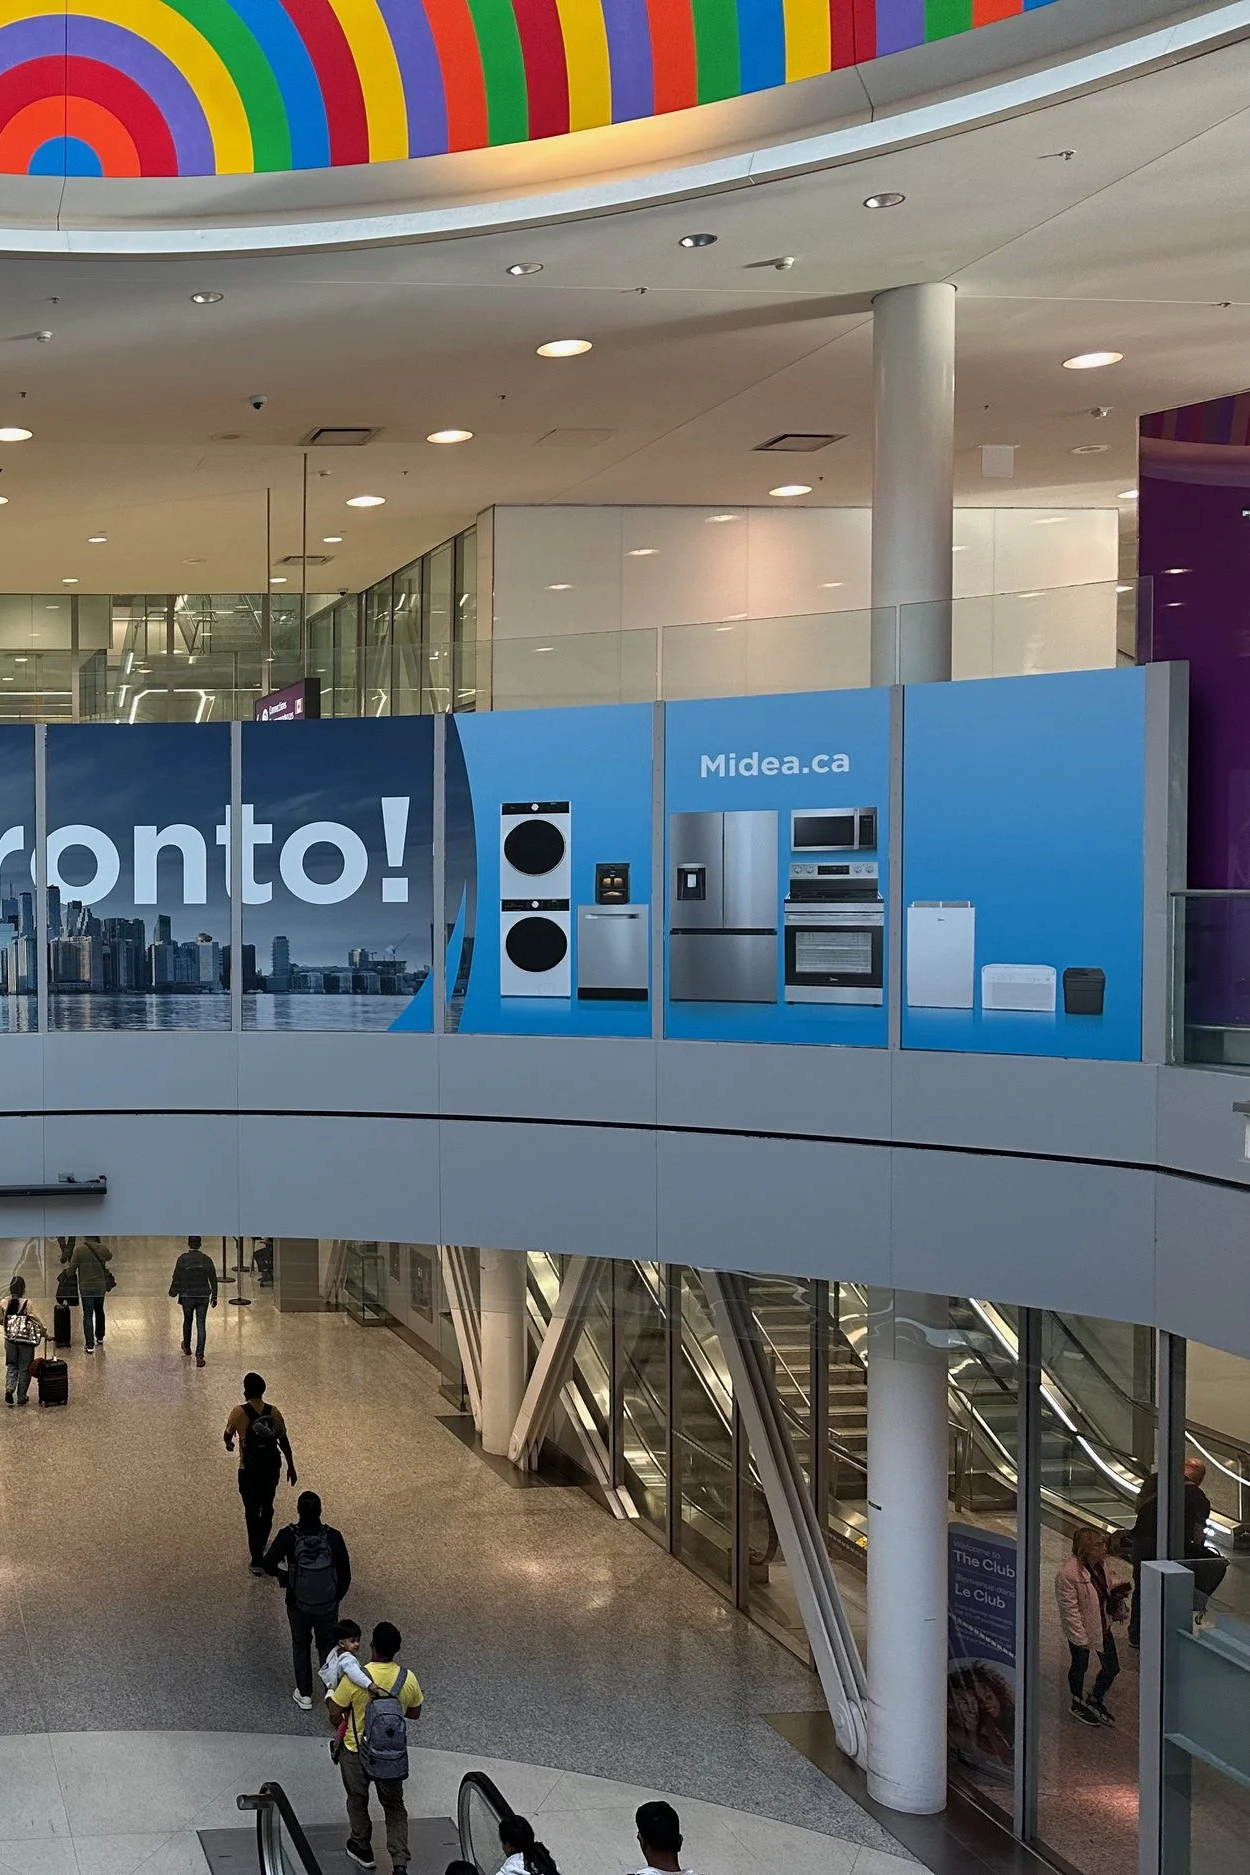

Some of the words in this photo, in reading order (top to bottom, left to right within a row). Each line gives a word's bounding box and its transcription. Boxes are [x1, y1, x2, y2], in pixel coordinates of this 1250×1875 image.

[701, 751, 850, 778] Midea.ca
[953, 1540, 991, 1556] Welcome
[992, 1551, 1001, 1559] to
[953, 1550, 980, 1567] The
[982, 1559, 1015, 1578] Club
[955, 1574, 995, 1591] Bienvenue
[955, 1583, 971, 1597] Le
[973, 1589, 1006, 1608] Club
